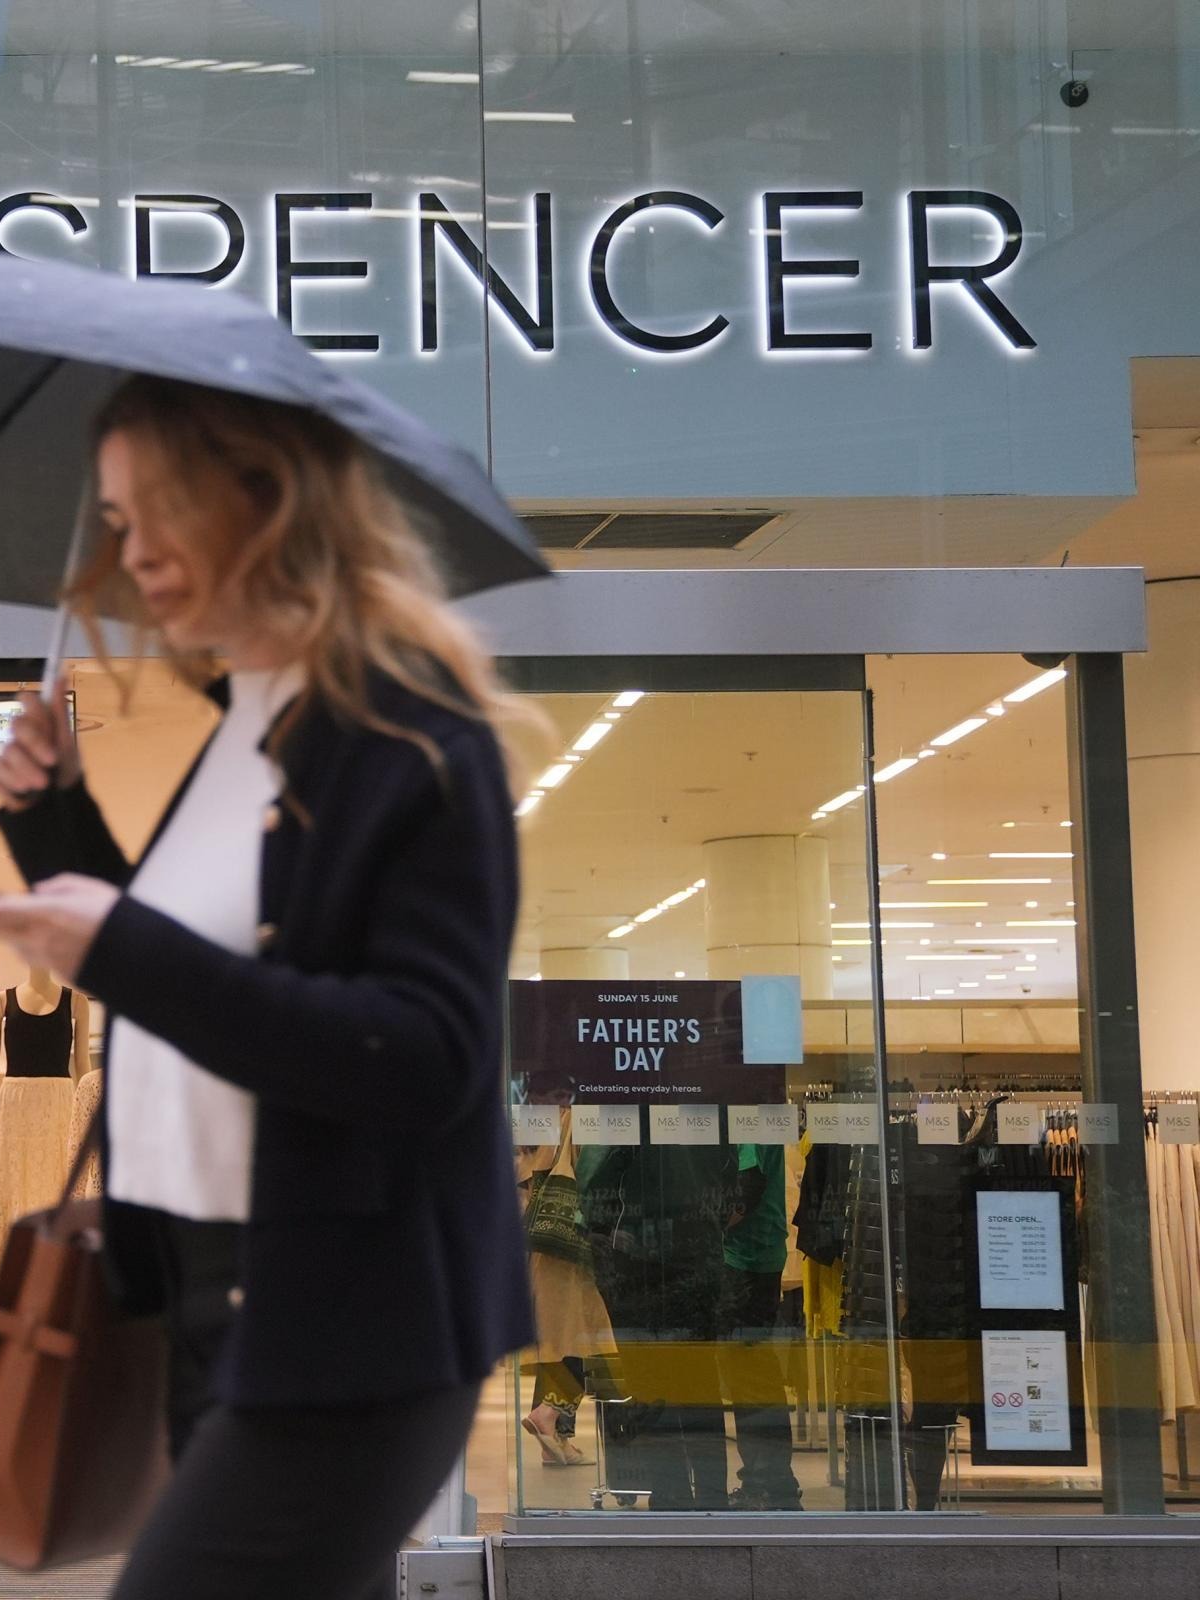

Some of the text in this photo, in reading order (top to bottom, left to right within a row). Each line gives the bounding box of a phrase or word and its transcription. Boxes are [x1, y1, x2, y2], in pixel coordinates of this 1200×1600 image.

[598, 994, 678, 1002] SUNDAY 15 JUNE
[577, 1018, 700, 1044] FATHER'S
[614, 1047, 664, 1071] DAY
[579, 1084, 701, 1094] Celebrating everyday heroes
[527, 1117, 552, 1127] M&S
[607, 1117, 631, 1126] M&S
[686, 1117, 711, 1126] M&S
[766, 1117, 791, 1126] M&S
[814, 1116, 839, 1125] M&S
[846, 1117, 870, 1126] M&S
[925, 1117, 950, 1126] M&S
[1005, 1117, 1030, 1126] M&S
[1085, 1117, 1110, 1126] M&S
[1166, 1117, 1191, 1126] M&S
